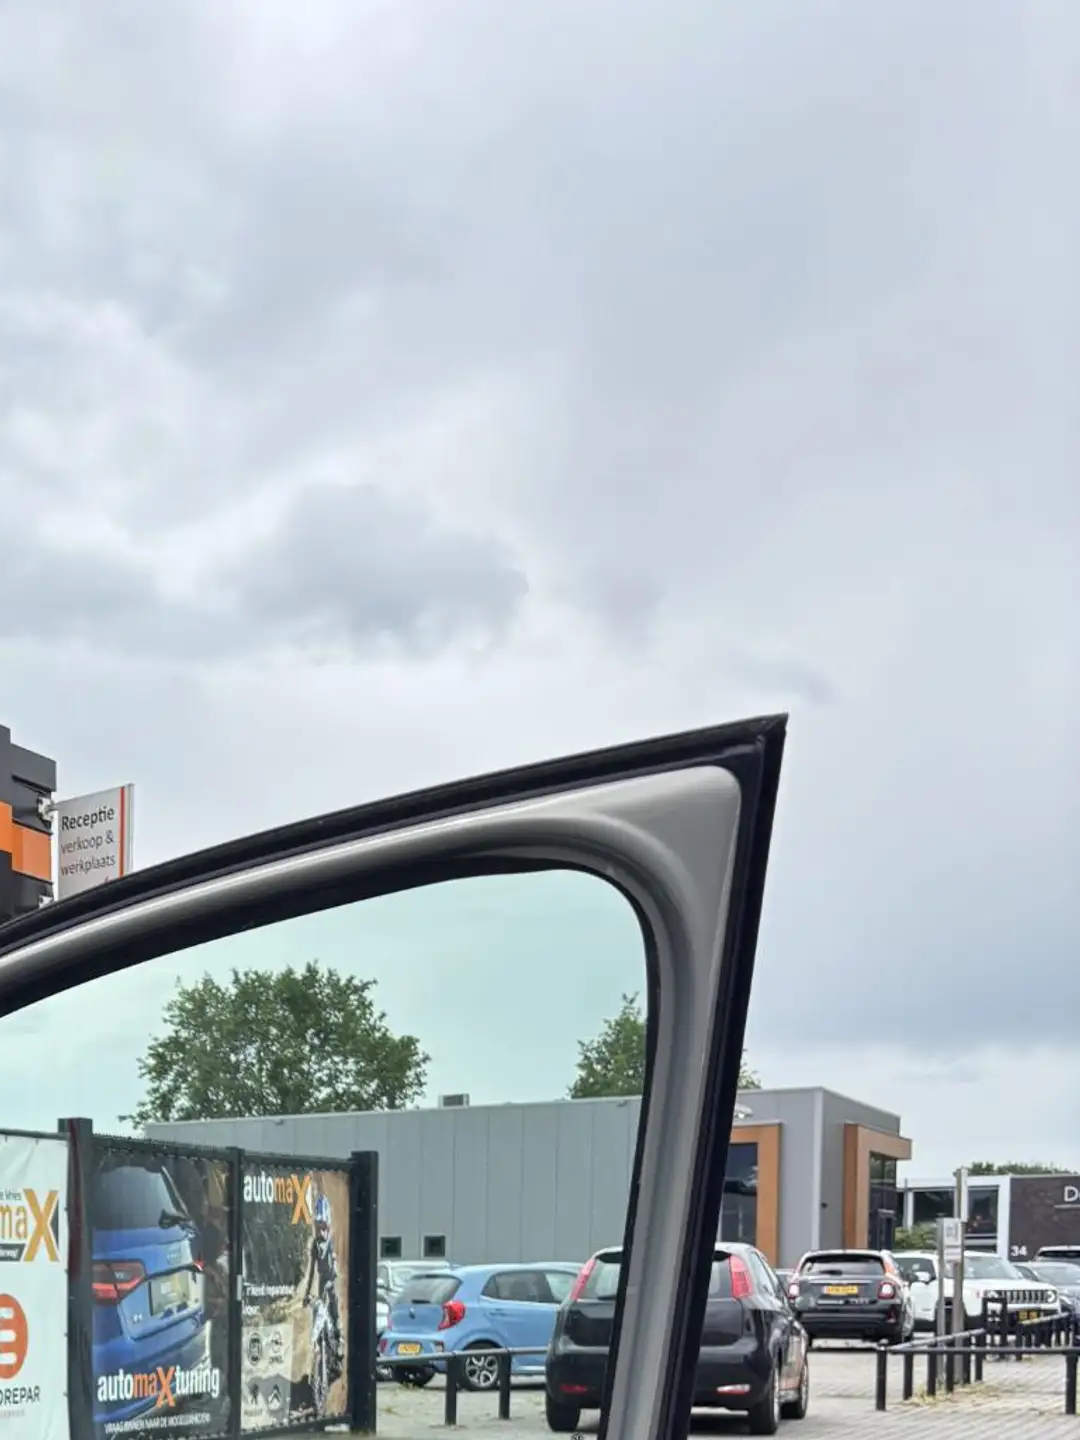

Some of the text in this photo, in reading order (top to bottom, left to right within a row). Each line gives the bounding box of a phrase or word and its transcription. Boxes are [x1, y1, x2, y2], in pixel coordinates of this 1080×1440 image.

[61, 805, 115, 831] Receptie
[61, 829, 114, 855] verkoop &
[61, 854, 116, 876] werkplaats
[243, 1170, 313, 1225] automaX
[1064, 1185, 1080, 1203] D
